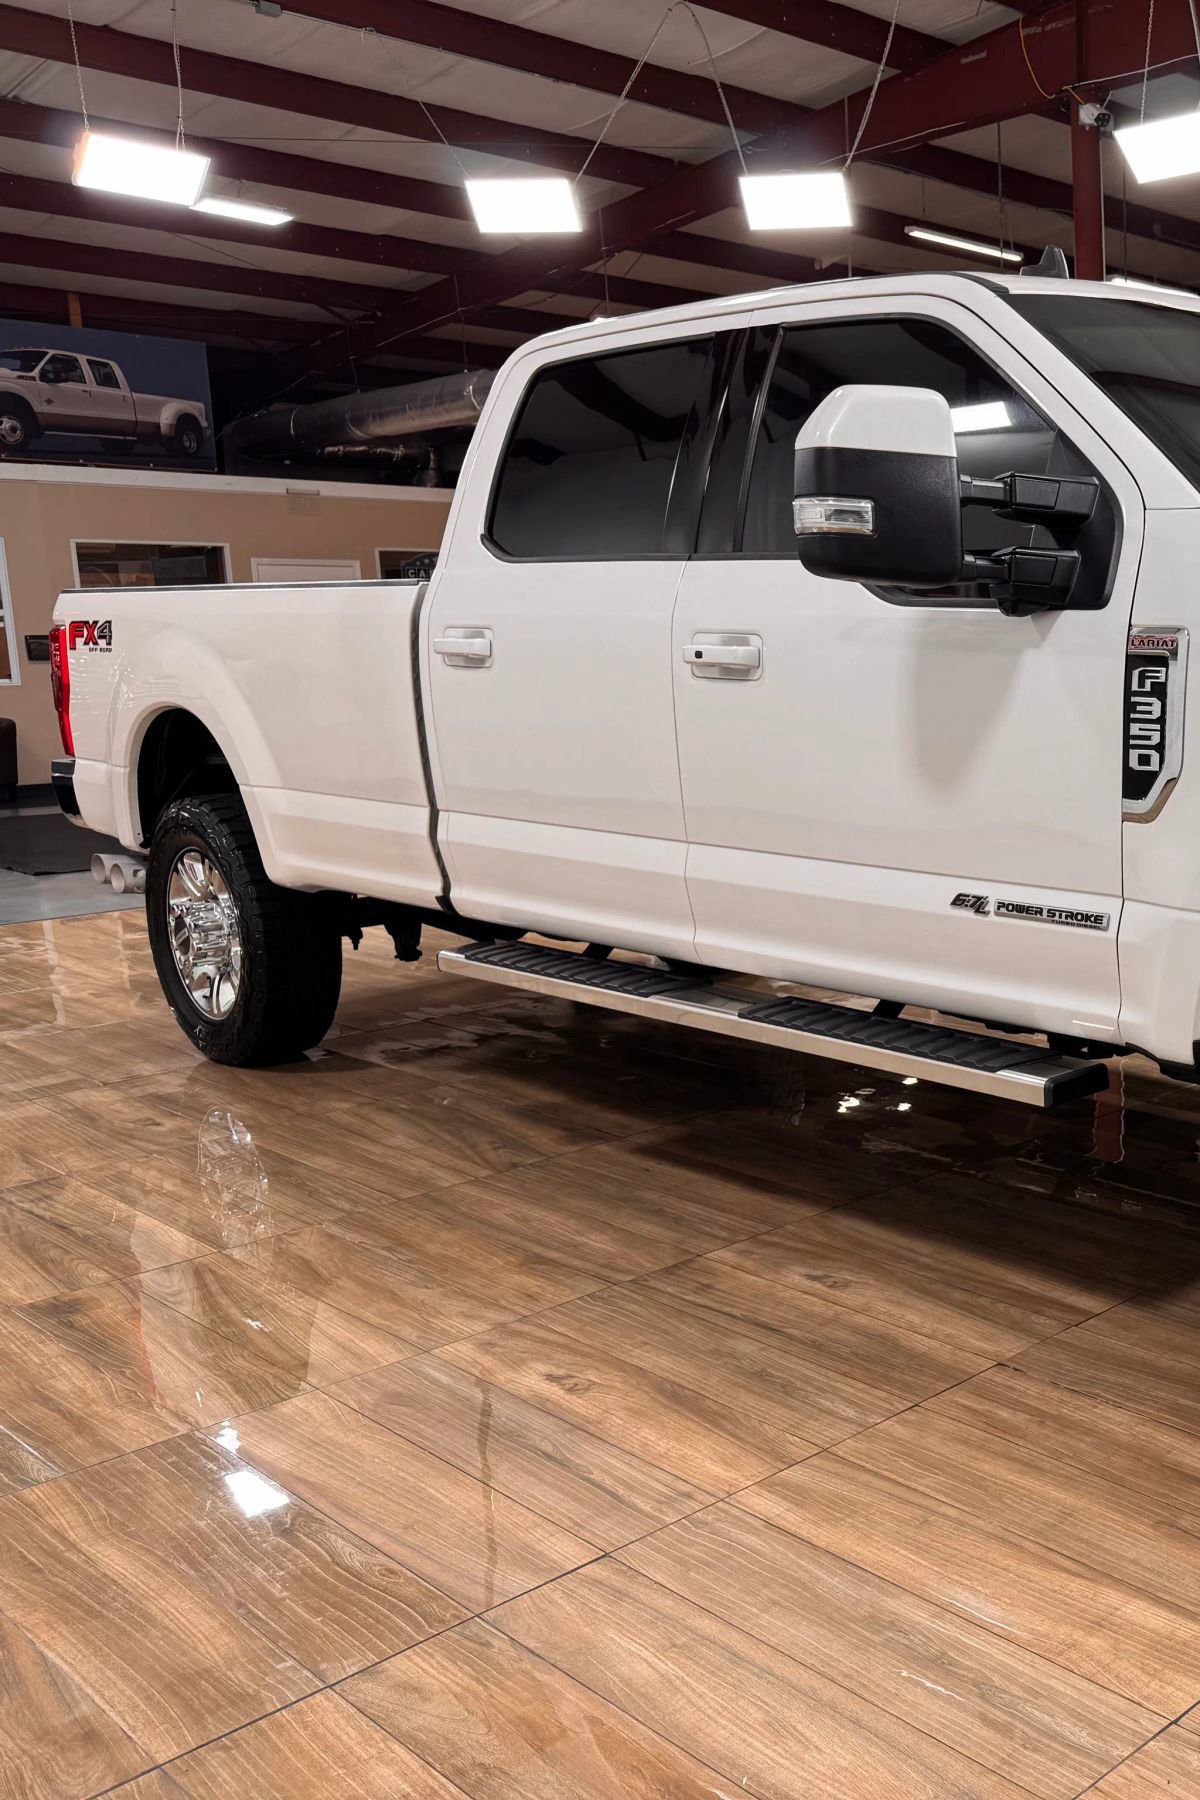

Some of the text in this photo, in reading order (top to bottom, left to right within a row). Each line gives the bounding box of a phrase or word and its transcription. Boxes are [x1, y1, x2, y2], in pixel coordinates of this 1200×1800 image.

[69, 620, 113, 651] FX4
[1130, 637, 1177, 649] LARIAT
[1129, 666, 1167, 772] F350
[950, 892, 1104, 925] 6.7L POWER STROKE
[1052, 919, 1076, 927] TURBO
